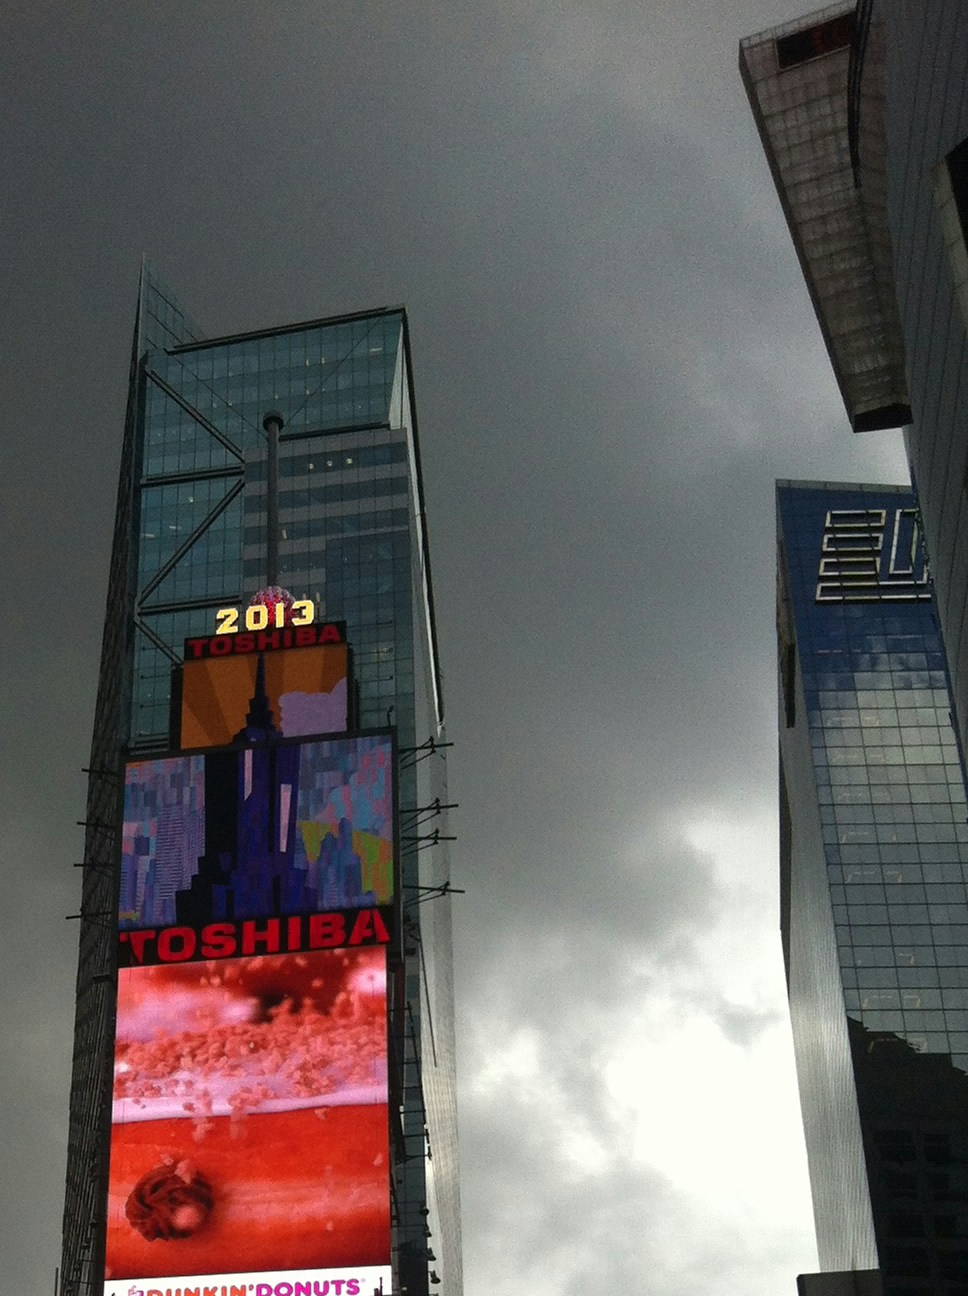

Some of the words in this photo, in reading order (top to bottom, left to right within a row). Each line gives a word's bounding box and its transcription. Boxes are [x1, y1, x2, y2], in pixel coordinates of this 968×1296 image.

[215, 600, 315, 634] 2013
[188, 625, 342, 658] TOSHIBA
[119, 908, 391, 965] TOSHIBA
